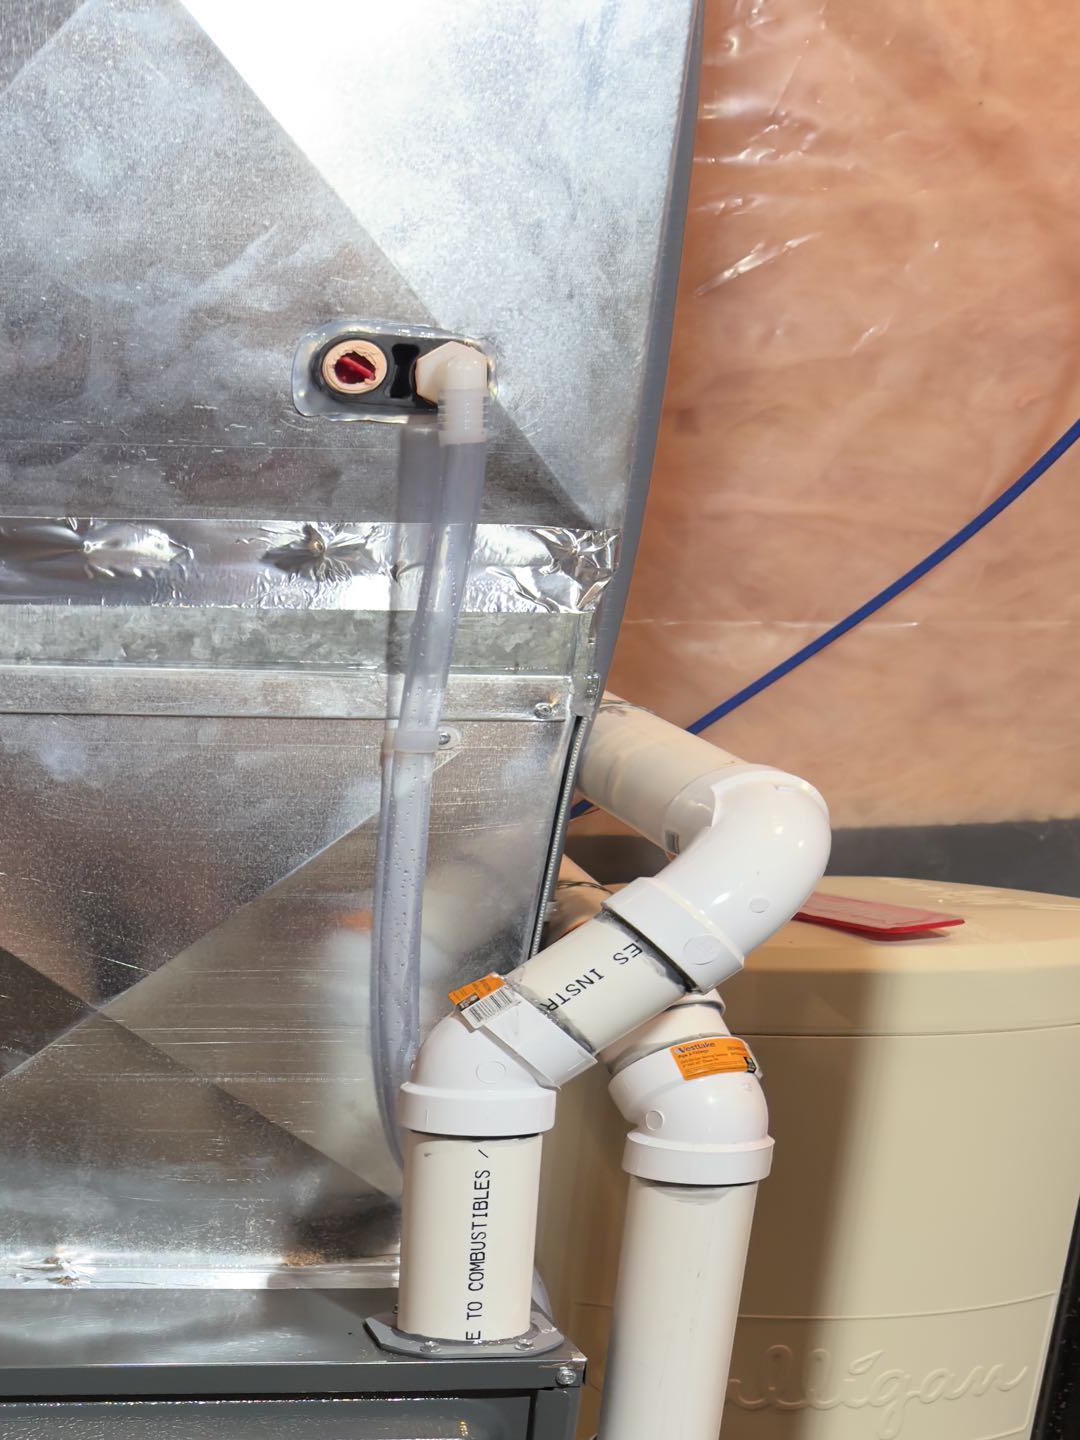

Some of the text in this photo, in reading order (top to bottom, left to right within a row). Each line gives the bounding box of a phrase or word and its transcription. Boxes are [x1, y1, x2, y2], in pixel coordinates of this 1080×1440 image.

[540, 968, 604, 1012] INSTR
[468, 1168, 491, 1293] COMBUSTIBLES
[466, 1299, 483, 1321] TO
